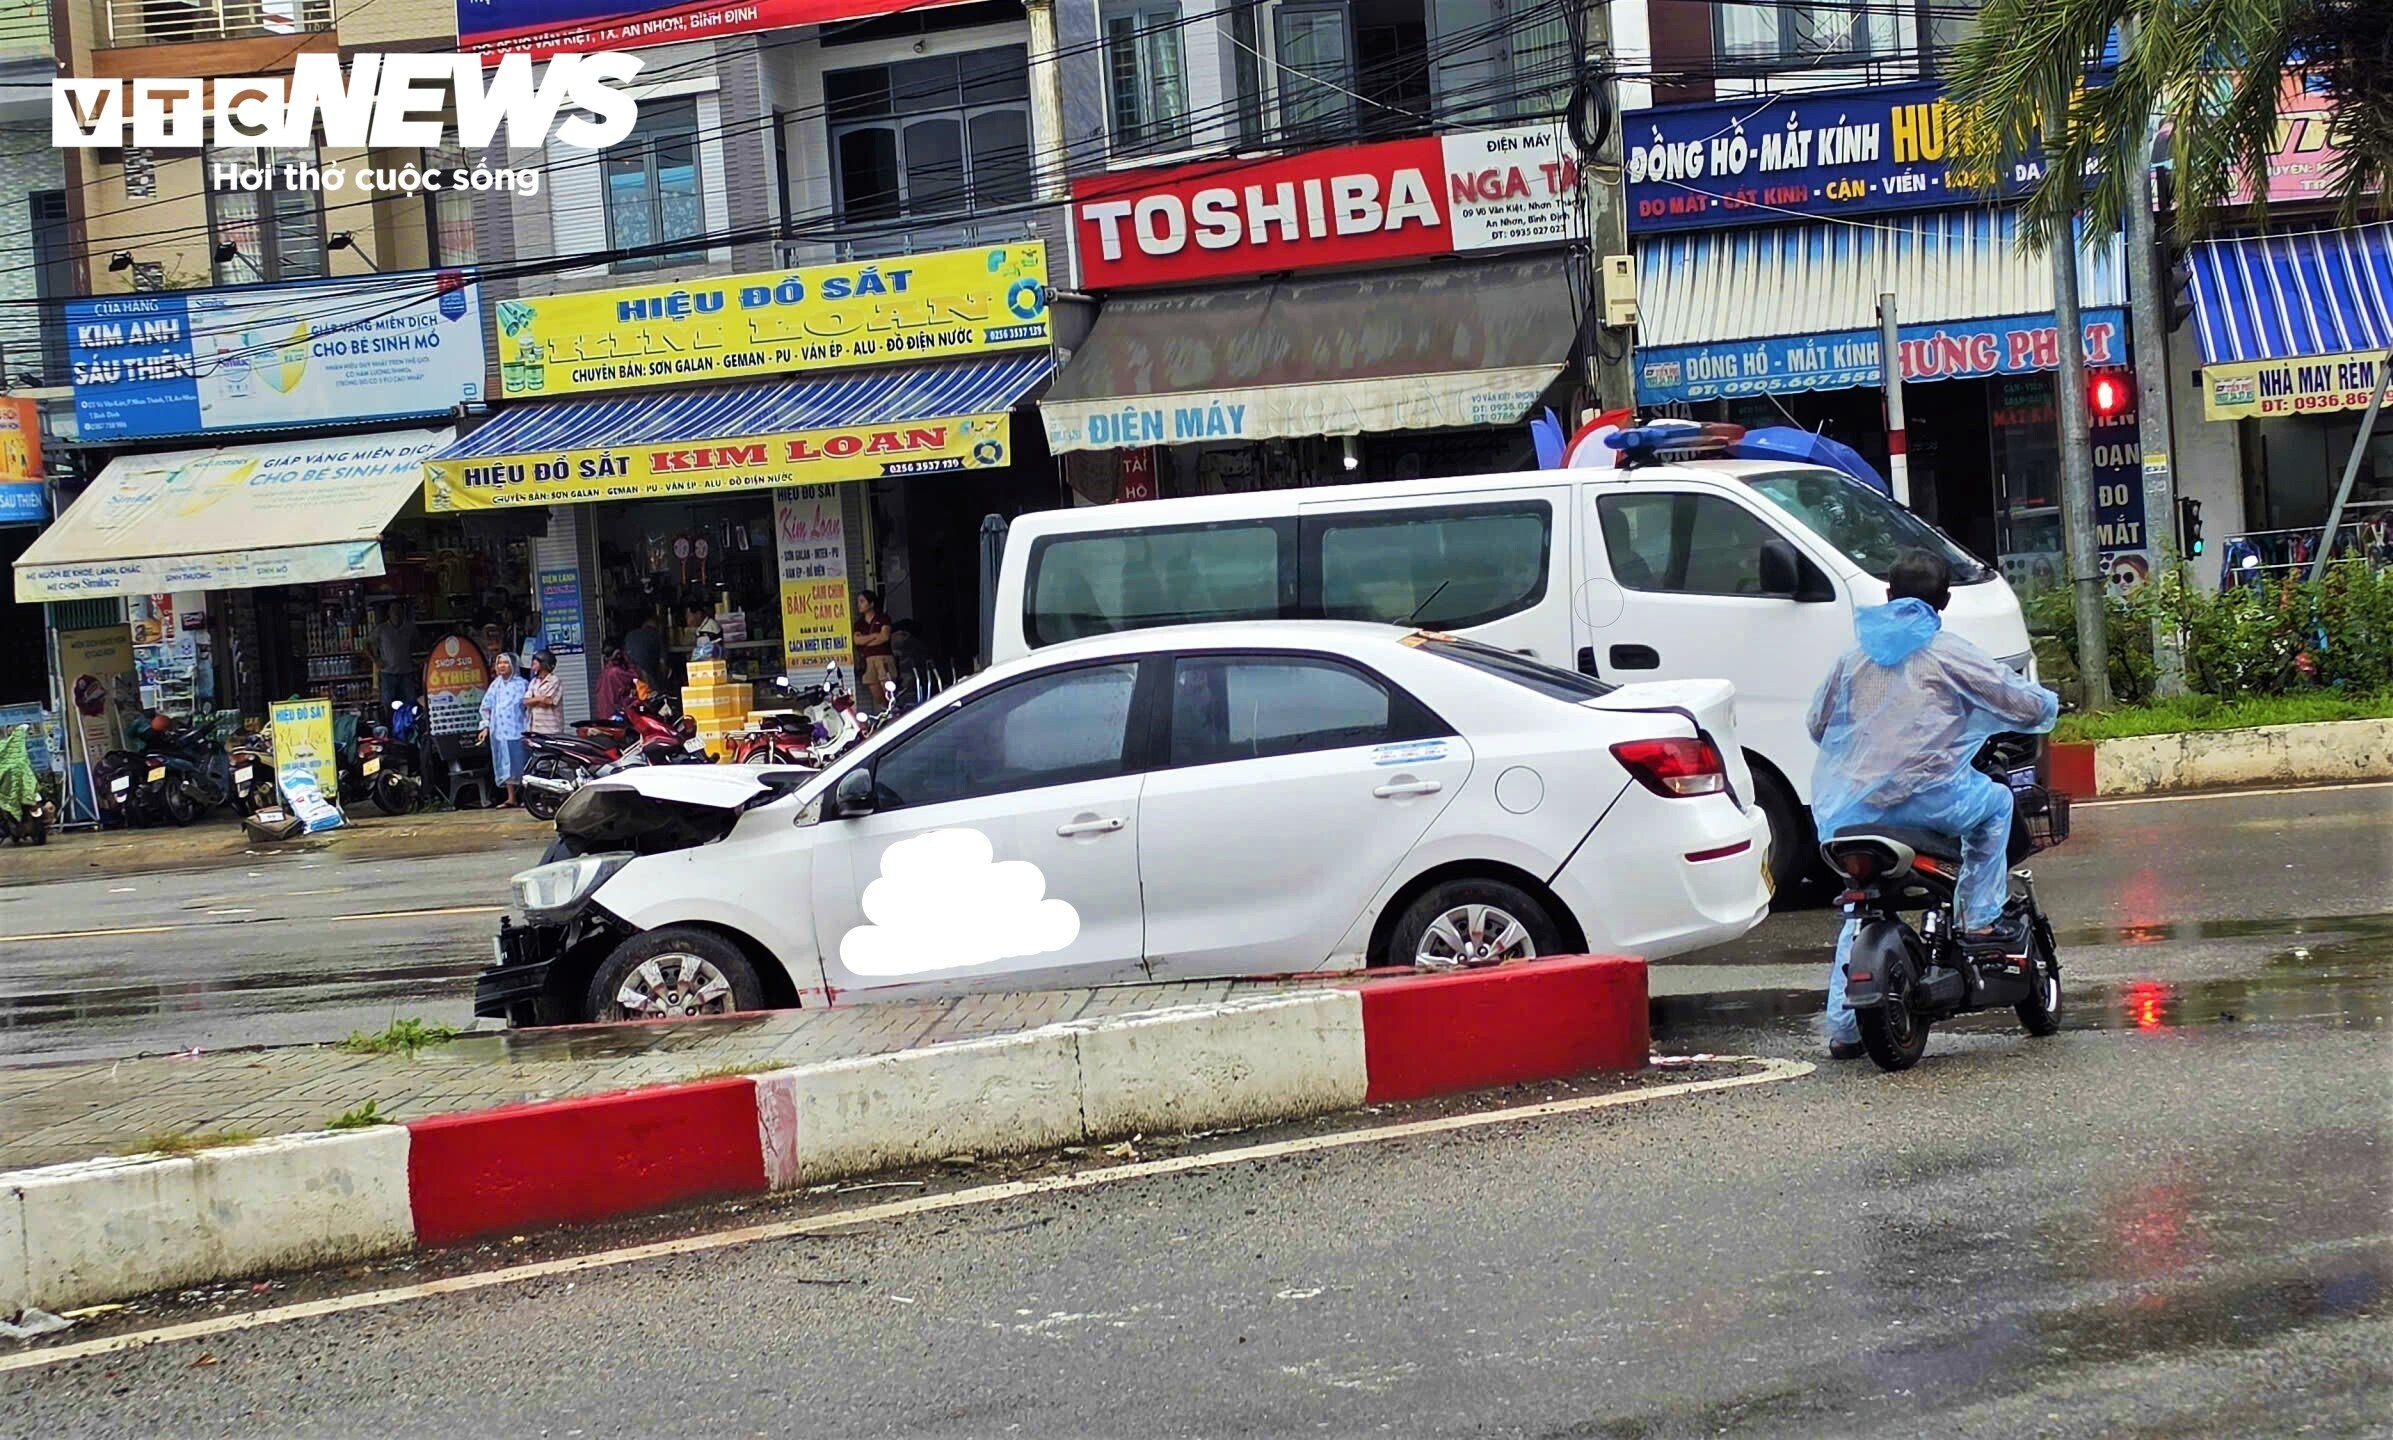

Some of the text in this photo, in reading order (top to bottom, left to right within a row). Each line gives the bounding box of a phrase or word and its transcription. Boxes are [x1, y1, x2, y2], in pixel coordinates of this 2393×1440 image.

[622, 24, 641, 38] AN
[646, 16, 688, 34] NHƠN,
[690, 11, 722, 28] BÌNH
[724, 6, 758, 24] ĐỊNH
[1487, 132, 1551, 154] ĐIỆN MÁY
[1629, 124, 1705, 184] ĐỒNG
[1817, 113, 1880, 166] KÍNH
[1450, 166, 1531, 204] NGA
[1639, 199, 1666, 218] ĐO
[1763, 184, 1808, 206] KÍNH
[1825, 177, 1867, 202] CẬN
[2015, 163, 2042, 182] ĐA
[1082, 167, 1441, 261] TOSHIBA
[1462, 208, 1474, 218] 09
[1528, 200, 1552, 210] Nhơn
[1486, 220, 1498, 229] An
[1500, 217, 1526, 228] Nhơn,
[1510, 227, 1532, 238] 0935
[1533, 226, 1549, 235] 027
[616, 265, 913, 322] HIỆU ĐỒ SẮT
[77, 318, 180, 349] KIM ANH
[409, 314, 438, 330] DỊCH
[313, 341, 347, 358] CHO
[350, 336, 370, 355] BÉ
[372, 335, 410, 353] SINH
[572, 326, 973, 383] CHUYÊN BÁN: SƠN GALAN GEMAN PU VÁN ÉP ALU ĐỒ ĐIỆN NƯỚC
[1685, 348, 1738, 381] ĐỒNG
[1743, 343, 1769, 376] HỒ
[1787, 338, 1828, 373] MẮT
[1832, 339, 1880, 369] KÍNH
[2006, 321, 2114, 370] PHT
[73, 353, 121, 386] SÁU
[1687, 370, 1881, 396] ĐT: 0905.667.558
[2258, 361, 2294, 397] NHÀ
[2298, 364, 2332, 394] MAY
[2337, 356, 2375, 390] RÈM
[1175, 400, 1246, 439] MÁY
[2261, 399, 2289, 413] ĐT:
[463, 426, 948, 490] HIỆU ĐỒ SẮT KIM LOAN
[249, 470, 298, 487] CHO
[300, 465, 329, 482] BÉ
[331, 463, 385, 480] SINH
[570, 488, 600, 499] GALAN
[704, 479, 721, 488] ALU
[2099, 484, 2129, 507] ĐO
[429, 670, 440, 686] 6
